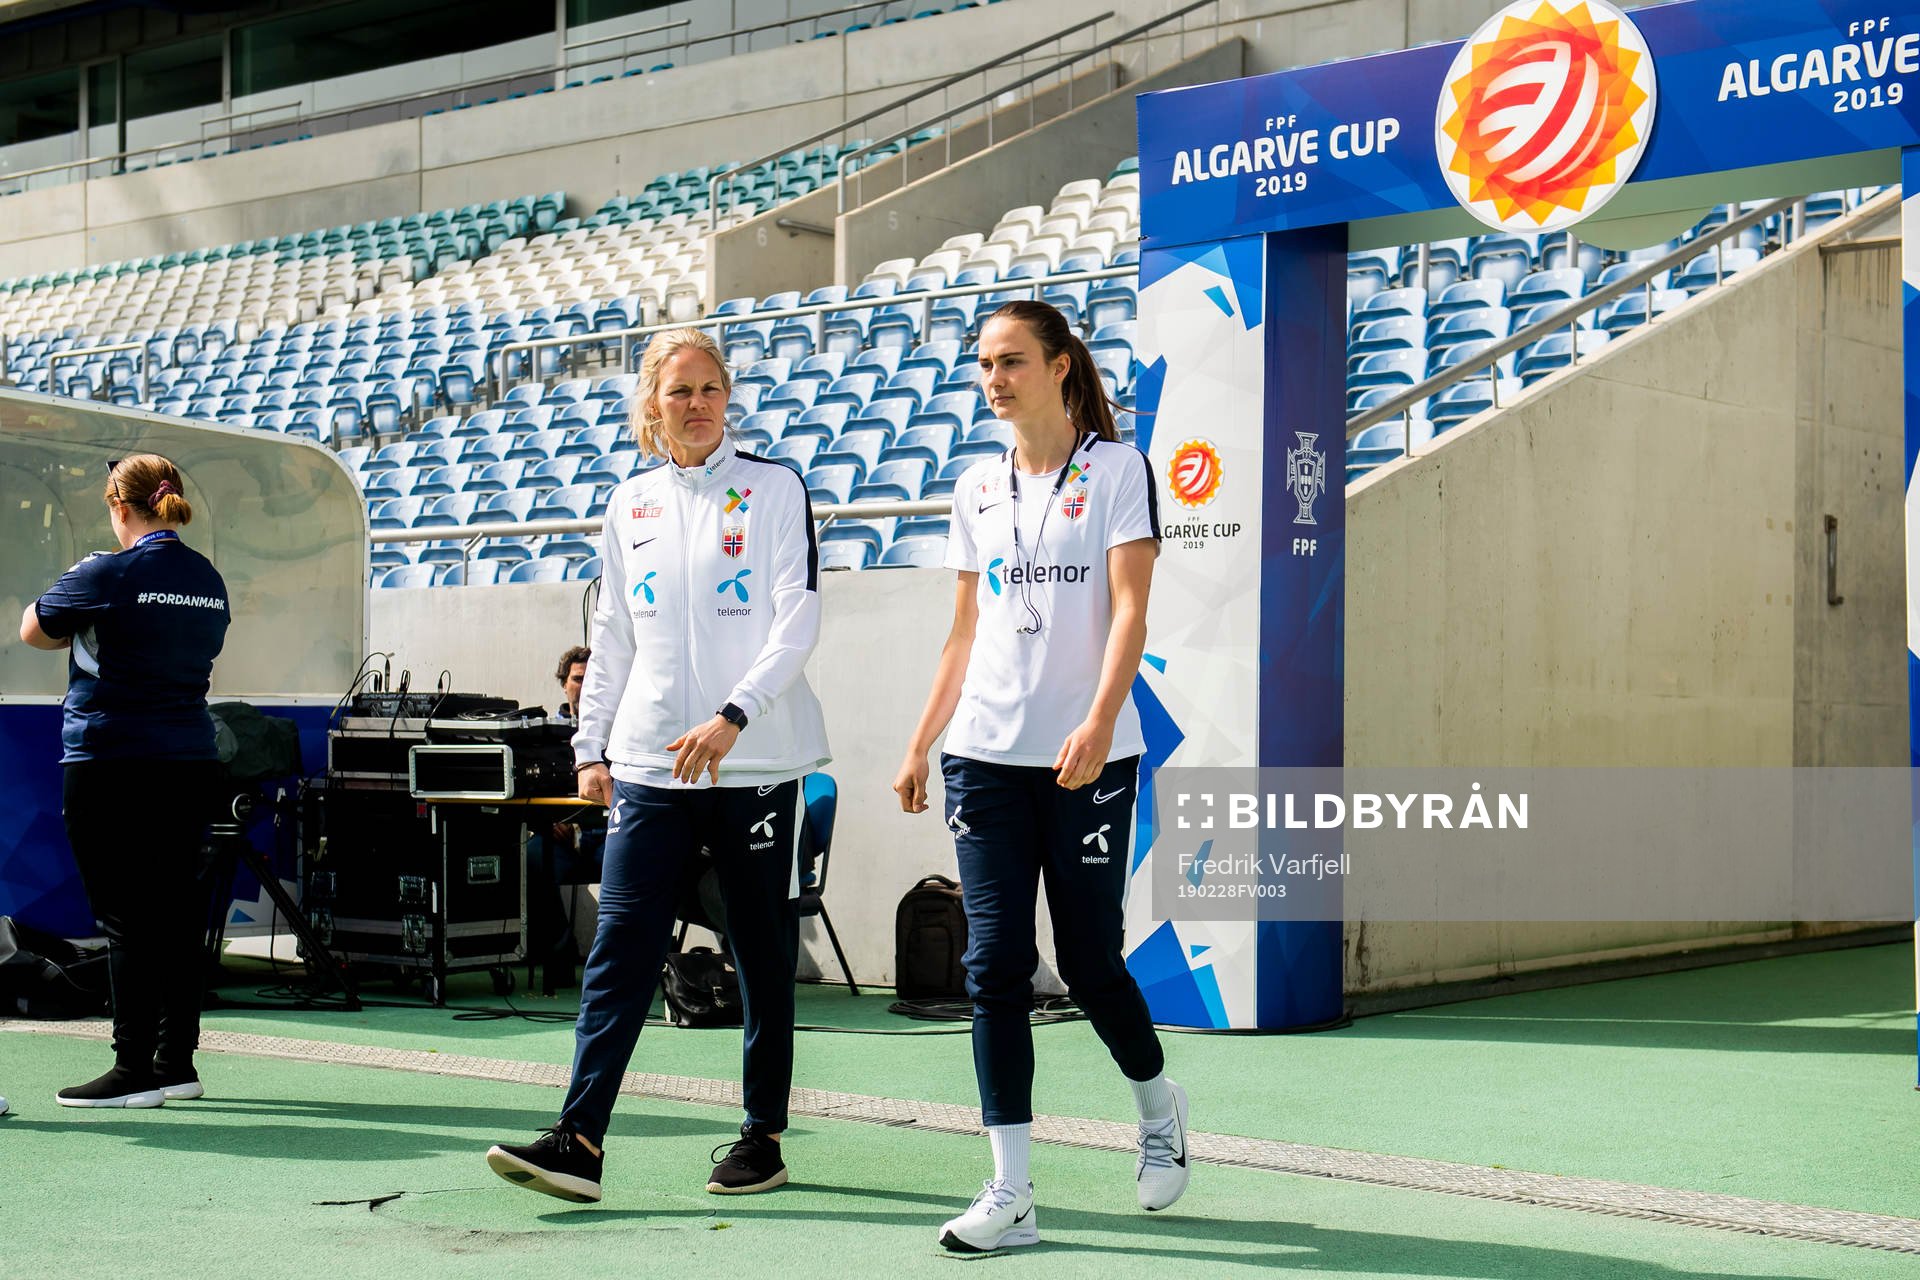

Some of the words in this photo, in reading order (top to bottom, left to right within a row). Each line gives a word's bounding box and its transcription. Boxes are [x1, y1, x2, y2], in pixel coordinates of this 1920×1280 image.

[1849, 16, 1890, 37] FPF
[1717, 33, 1920, 102] ALGARVE
[1833, 83, 1903, 113] 2019
[1265, 115, 1297, 131] FPF
[1171, 129, 1319, 185] ALGARVE
[1329, 117, 1400, 159] CUP
[1255, 172, 1307, 197] 2019
[888, 211, 897, 230] 5
[757, 227, 767, 247] 6
[632, 507, 662, 519] TINE
[1160, 524, 1209, 539] GARVE
[1213, 523, 1241, 538] CUP
[1183, 541, 1204, 549] 2019
[1292, 538, 1317, 556] FPF
[1003, 561, 1090, 585] telenor
[137, 592, 225, 610] #FORDANMARK
[717, 607, 751, 617] telenor
[750, 840, 775, 850] telenor
[1082, 856, 1110, 864] telenor
